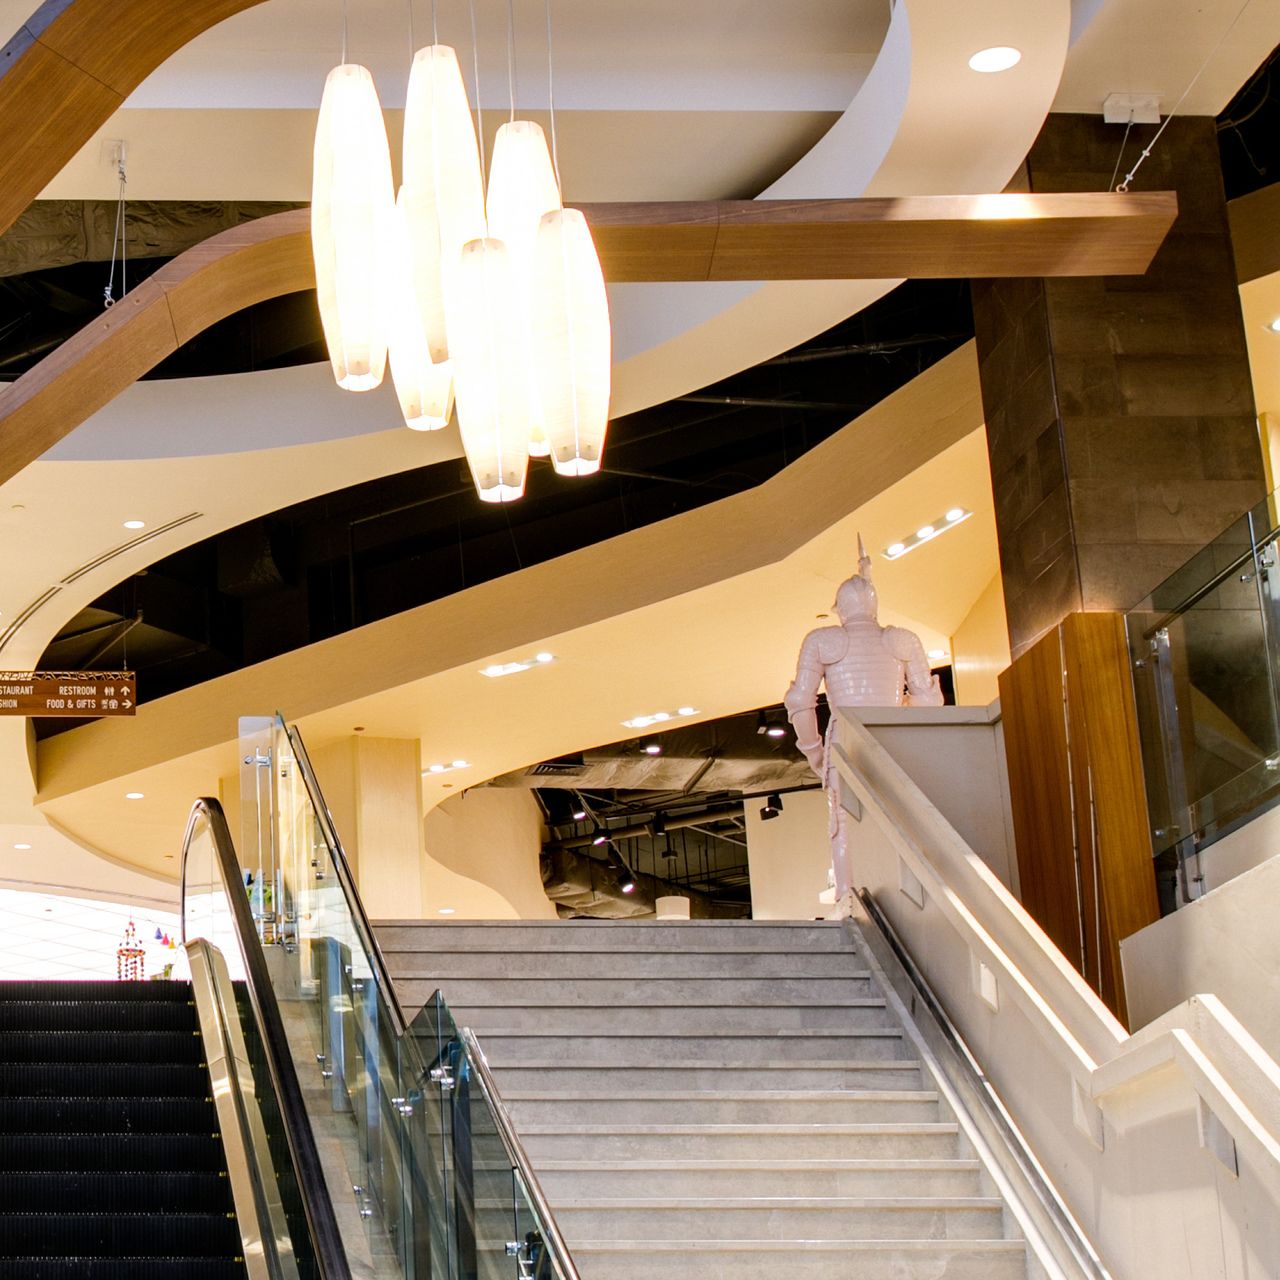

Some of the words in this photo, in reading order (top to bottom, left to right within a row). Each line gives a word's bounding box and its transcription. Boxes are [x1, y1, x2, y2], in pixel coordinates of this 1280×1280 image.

[59, 686, 96, 696] RESTROOM
[46, 699, 65, 709] FOOD
[67, 699, 74, 709] &
[76, 699, 96, 709] GIFTS
